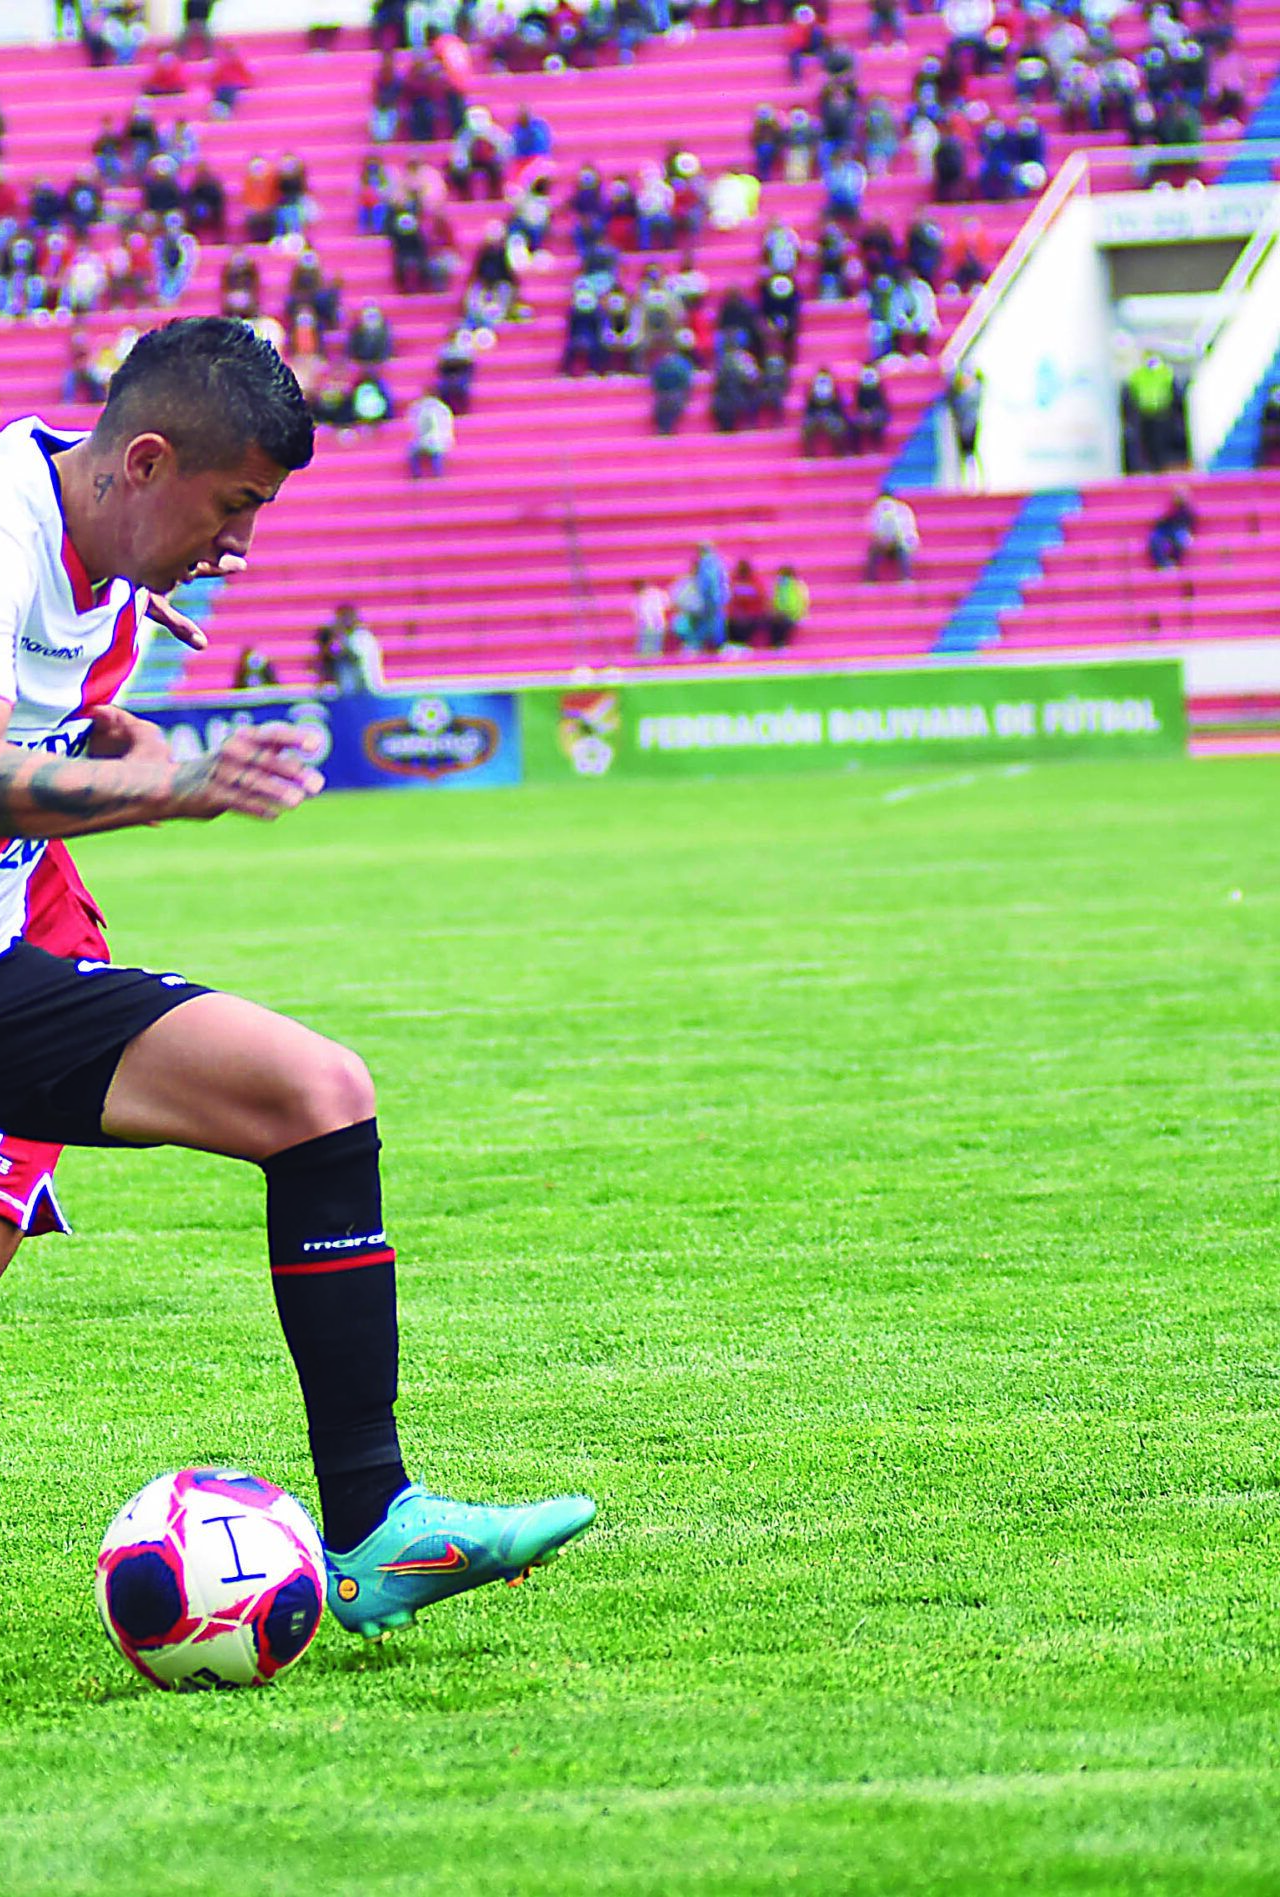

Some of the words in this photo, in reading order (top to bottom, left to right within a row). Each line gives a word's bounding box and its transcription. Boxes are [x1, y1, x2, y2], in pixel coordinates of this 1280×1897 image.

[637, 703, 822, 750] FEDERACIÓN
[827, 705, 987, 742] BOLIVIANA
[993, 702, 1037, 735] DE
[1043, 694, 1161, 735] FÚTBOL
